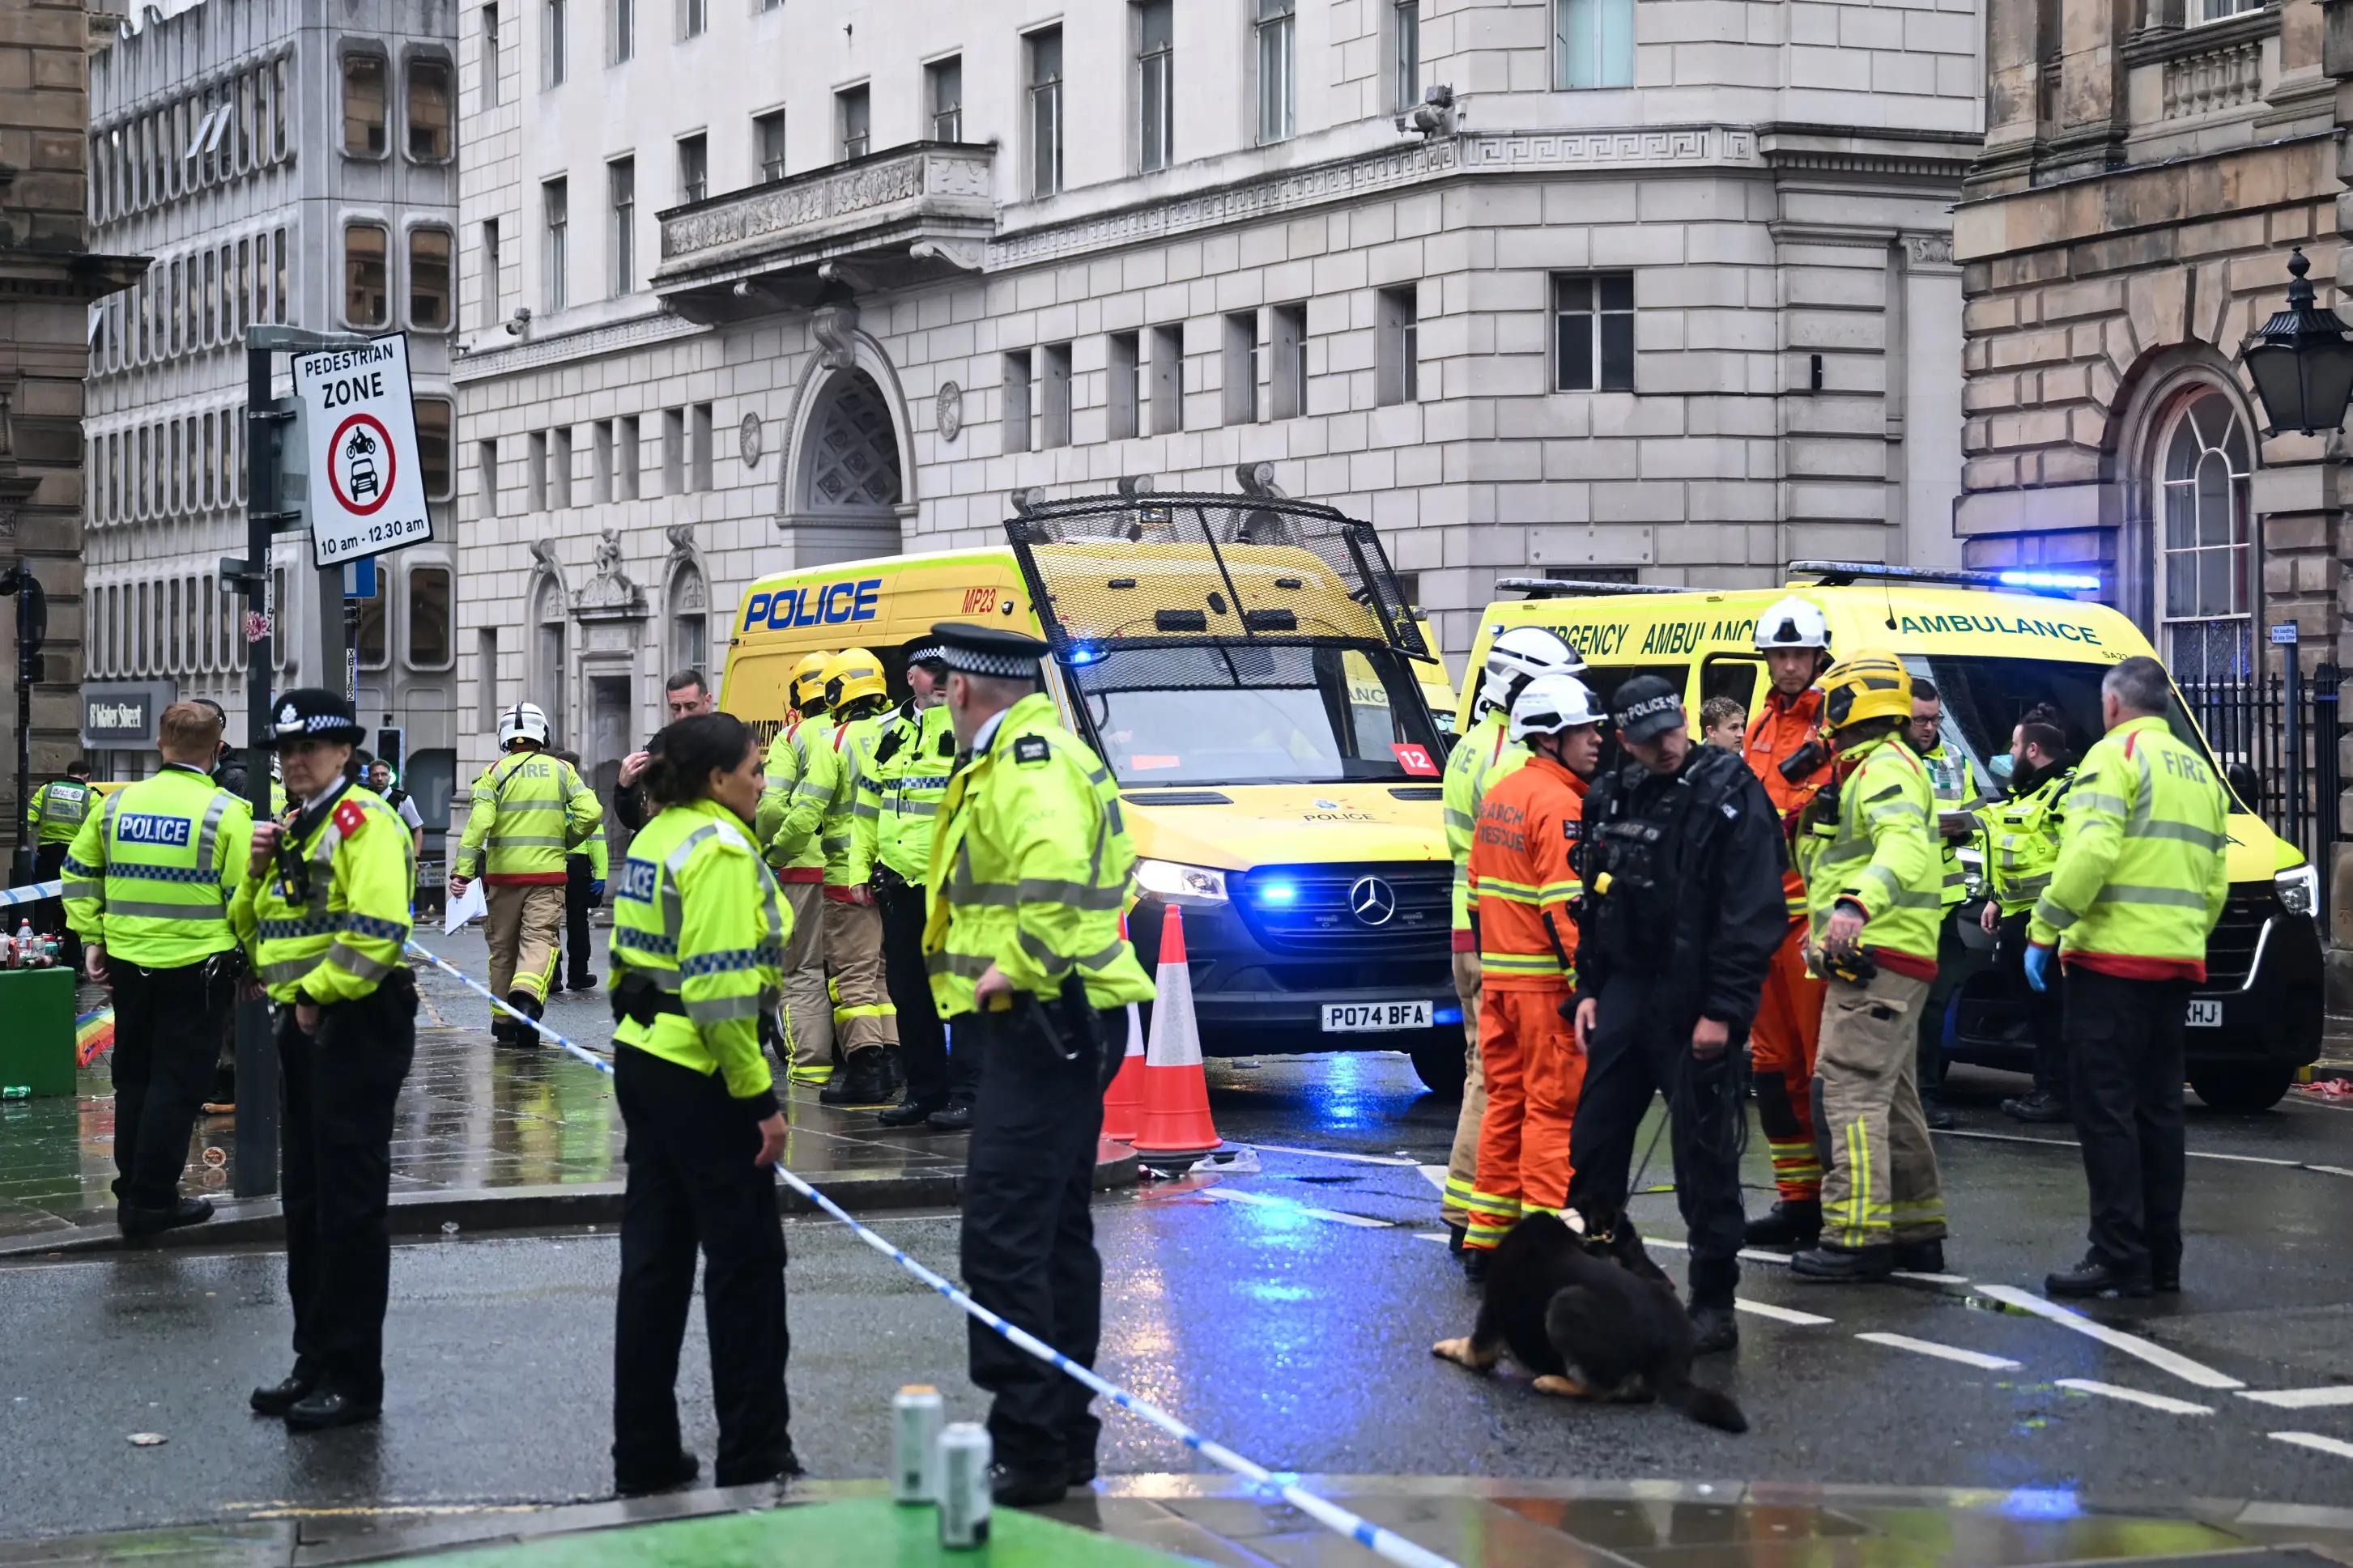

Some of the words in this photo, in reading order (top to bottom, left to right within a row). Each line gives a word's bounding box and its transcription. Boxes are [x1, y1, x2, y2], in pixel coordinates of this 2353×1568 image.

[305, 343, 394, 377] PEDESTRIAN
[322, 372, 384, 409] ZONE
[321, 538, 337, 555] 10
[340, 536, 358, 550] am
[368, 521, 402, 542] 12.30
[406, 519, 424, 533] am
[743, 579, 882, 631] POLICE
[961, 589, 996, 614] MP23
[1542, 624, 1630, 655] RGENCY
[1901, 615, 2102, 645] AMBULANCE
[90, 703, 96, 728] 8
[96, 703, 117, 728] Water
[118, 703, 142, 728] Street
[1628, 697, 1667, 720] POLICE
[510, 764, 551, 779] FIRE
[1399, 751, 1431, 768] 12
[2161, 750, 2208, 784] FIRE
[120, 817, 188, 842] POLICE
[1331, 1006, 1382, 1026] PO74
[1389, 1005, 1424, 1025] BFA
